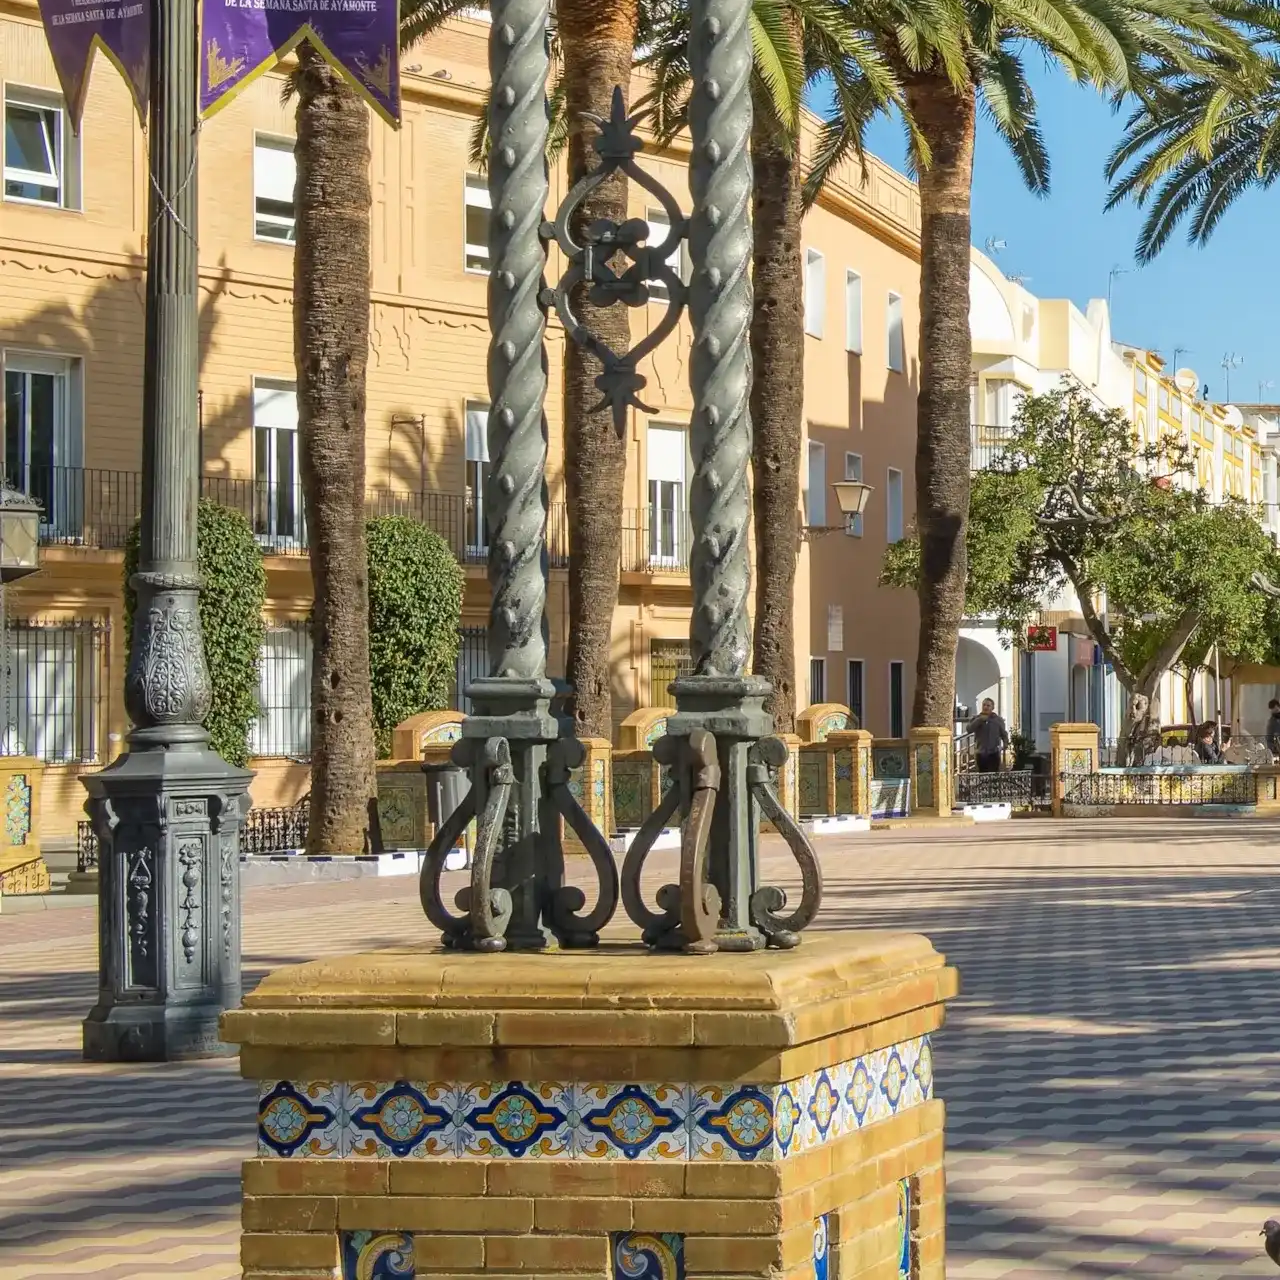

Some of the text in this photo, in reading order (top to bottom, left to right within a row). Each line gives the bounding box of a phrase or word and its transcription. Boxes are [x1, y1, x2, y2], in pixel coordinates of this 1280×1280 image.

[293, 0, 318, 11] SANTA
[320, 0, 329, 11] DE
[106, 8, 116, 19] DE
